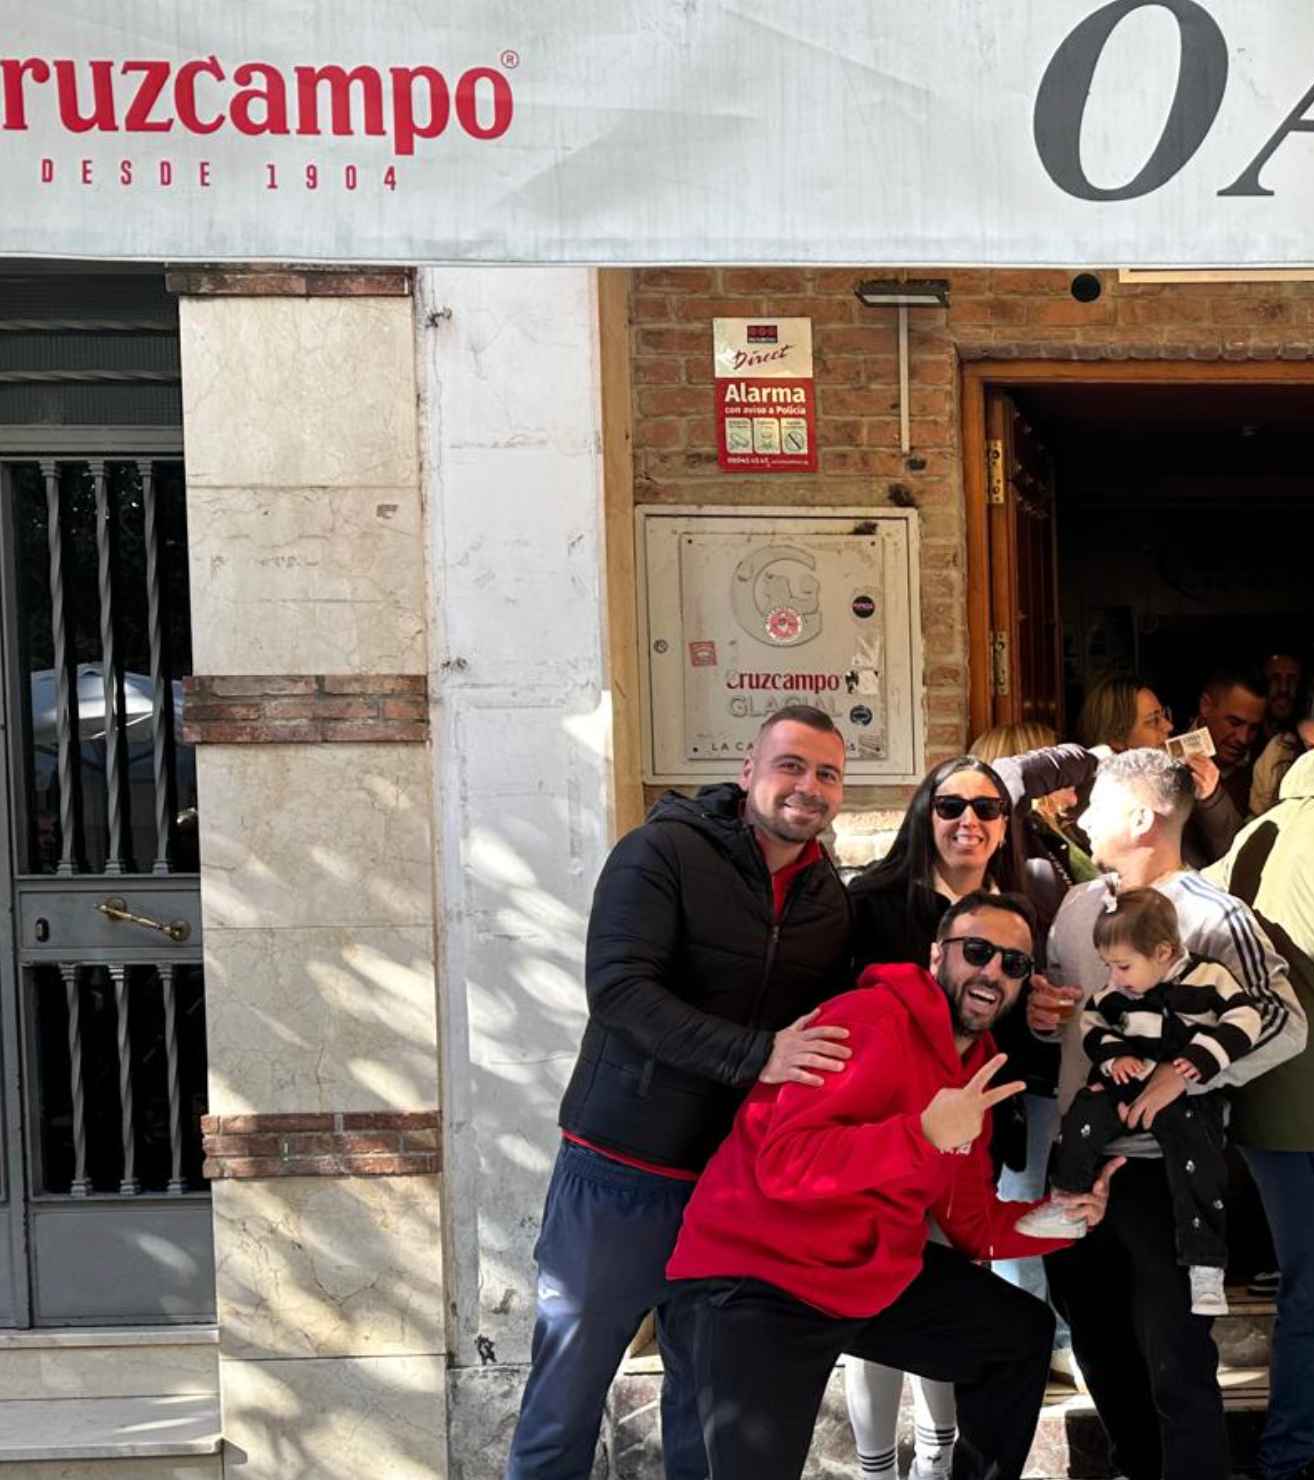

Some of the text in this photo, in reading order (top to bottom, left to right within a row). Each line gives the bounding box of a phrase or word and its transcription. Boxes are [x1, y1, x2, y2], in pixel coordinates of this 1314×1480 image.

[41, 158, 397, 191] DESDE 1904
[733, 344, 793, 369] Direct
[724, 382, 806, 403] Alarma
[724, 406, 741, 415] con
[768, 406, 775, 415] a
[726, 671, 840, 694] Cruzcampo
[711, 743, 728, 751] LA
